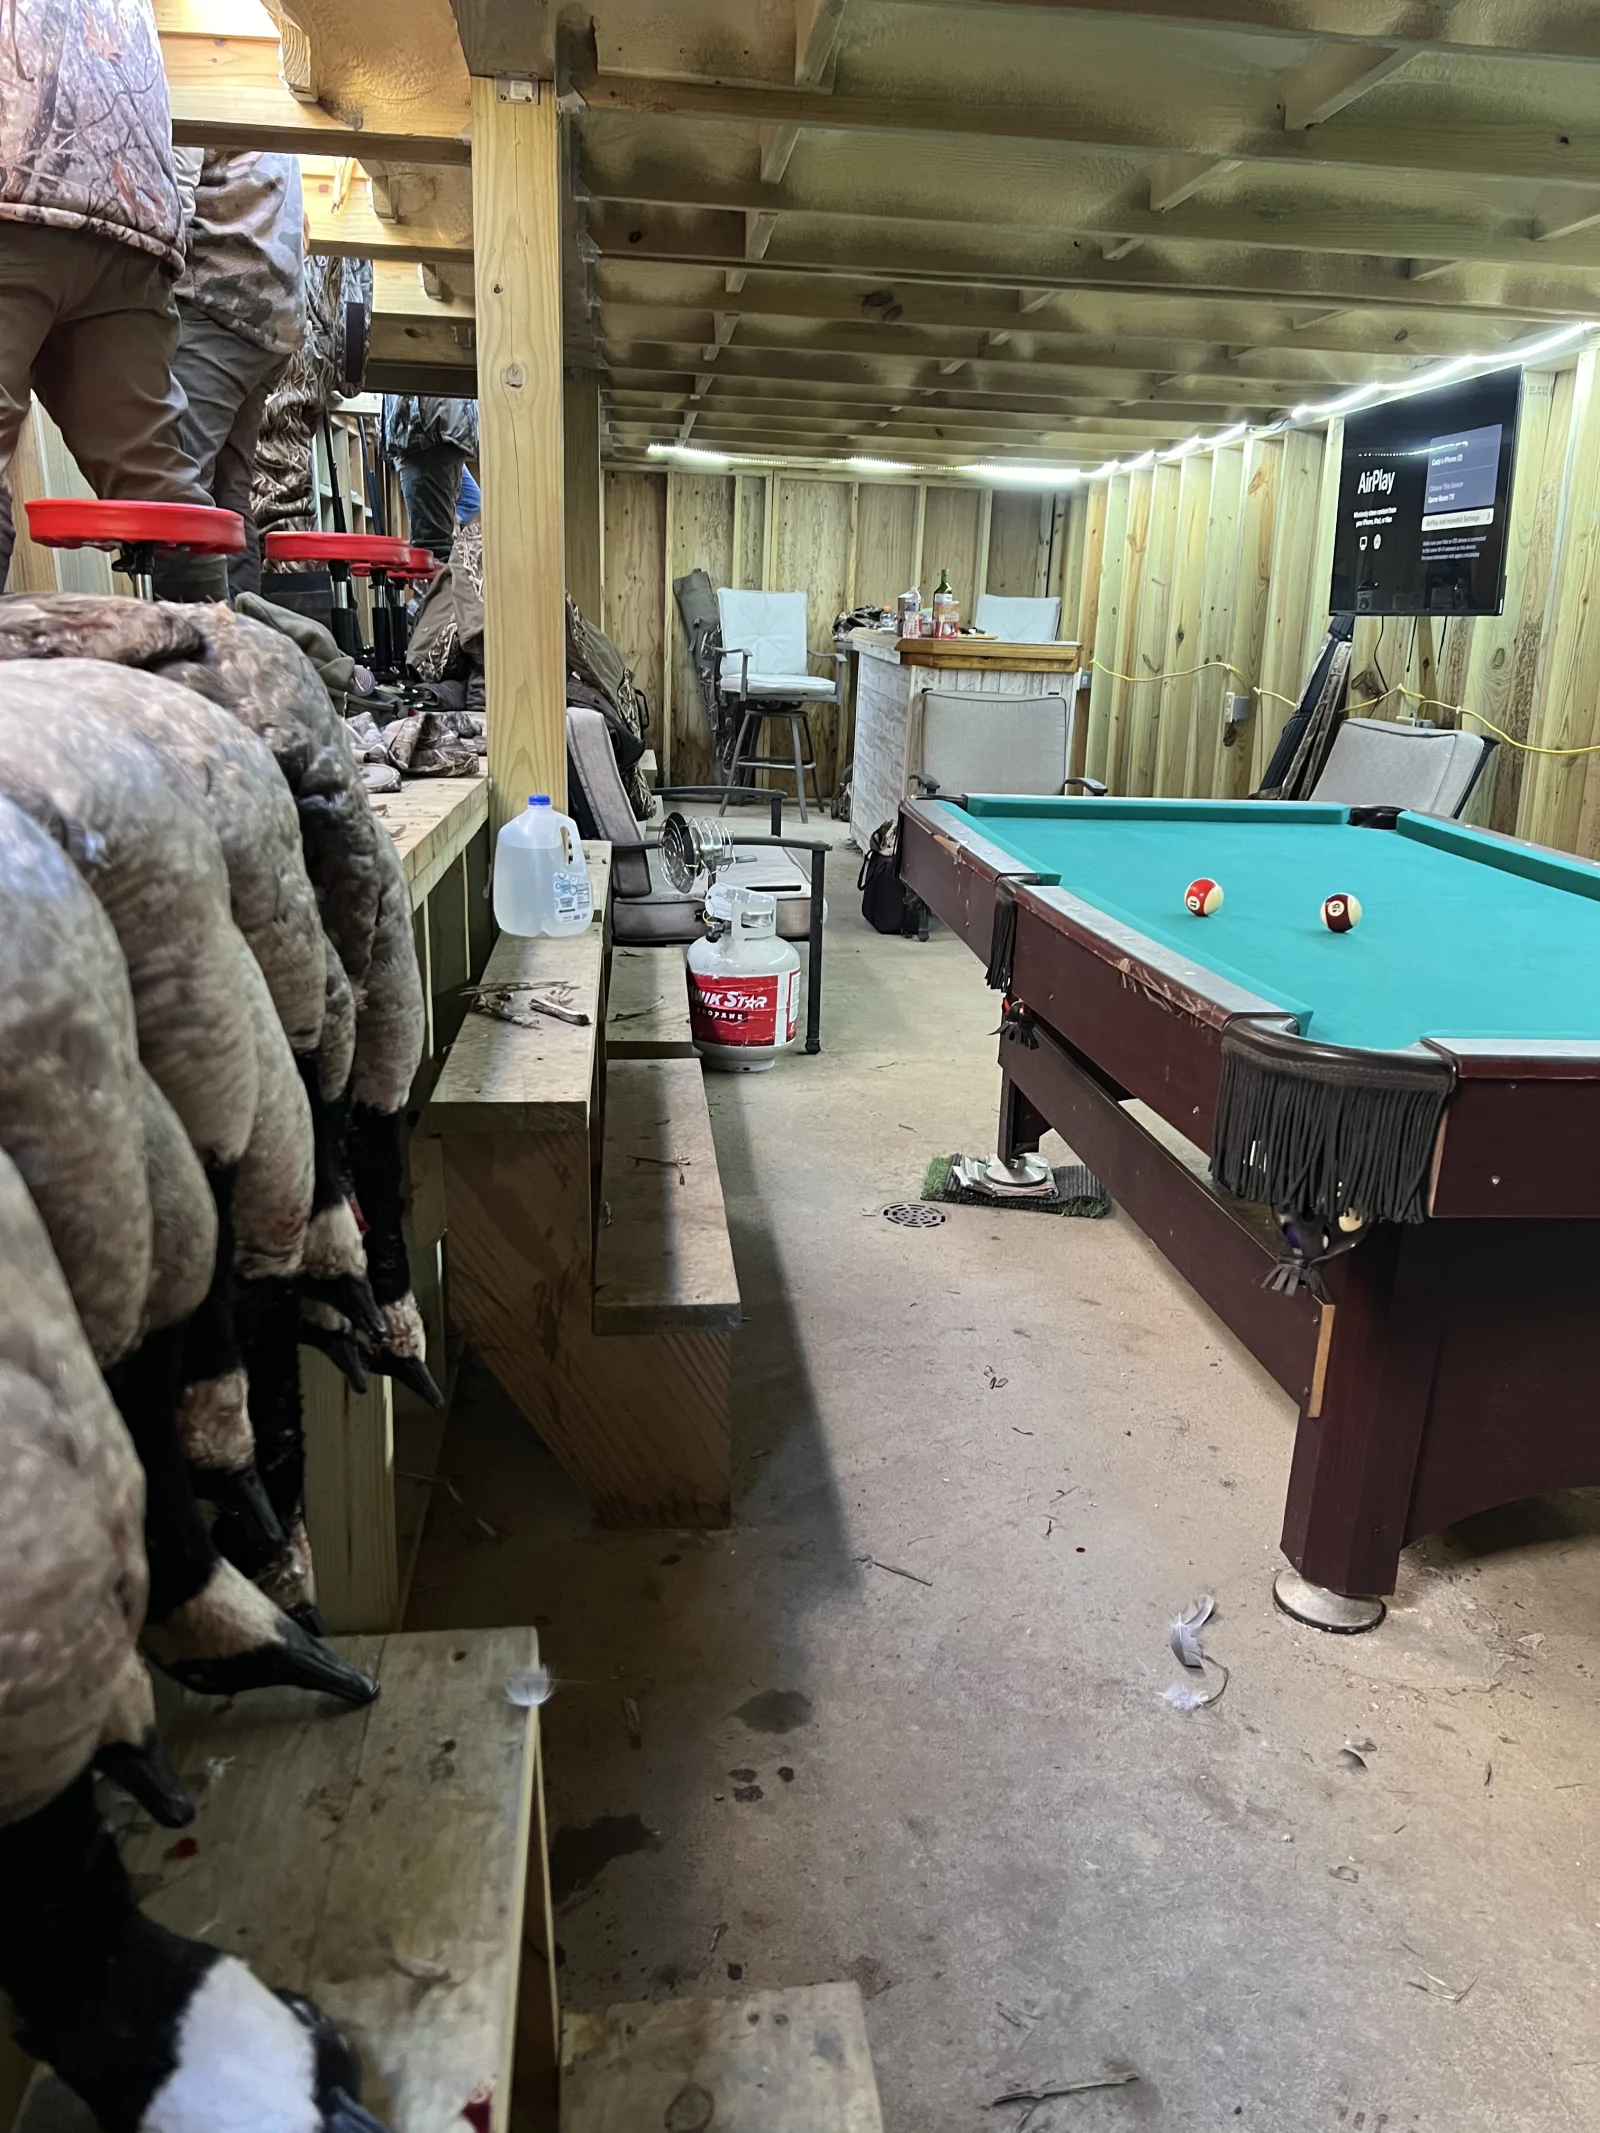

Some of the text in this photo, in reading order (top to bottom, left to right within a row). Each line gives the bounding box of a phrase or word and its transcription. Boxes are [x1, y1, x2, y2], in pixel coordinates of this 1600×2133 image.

[1357, 469, 1395, 494] AirPlay
[1190, 899, 1197, 908] 11
[724, 991, 768, 1010] STAR
